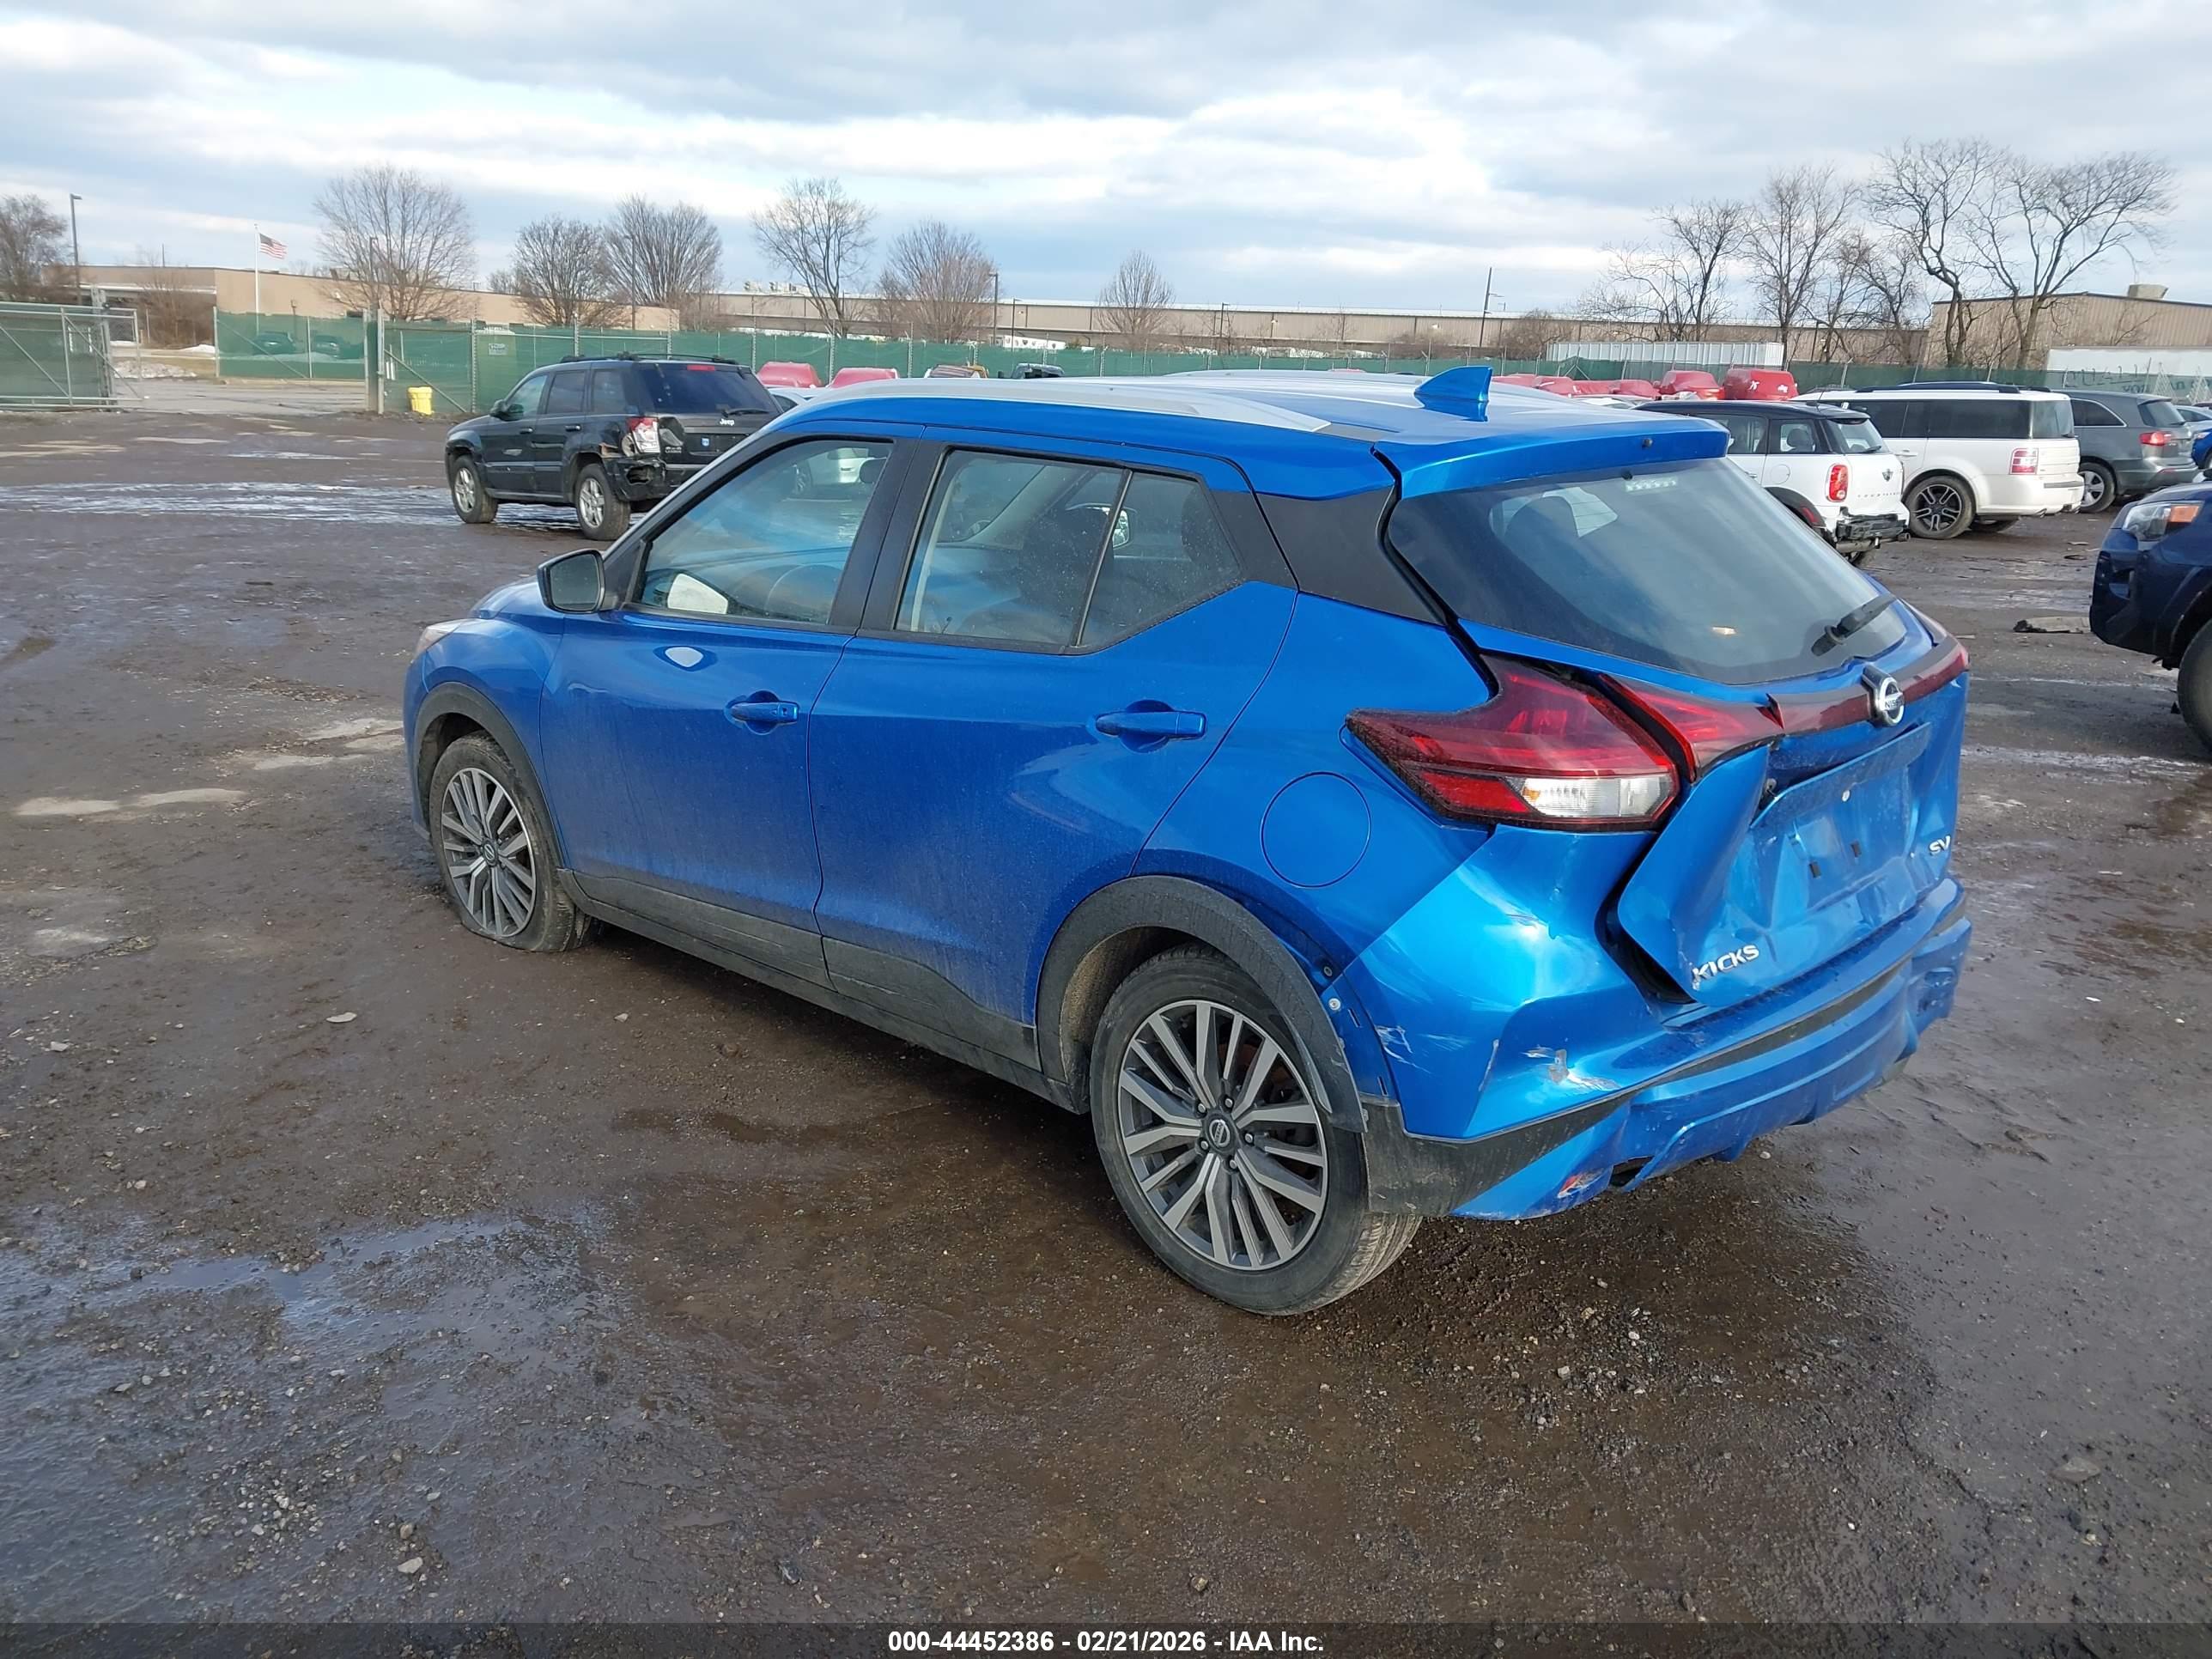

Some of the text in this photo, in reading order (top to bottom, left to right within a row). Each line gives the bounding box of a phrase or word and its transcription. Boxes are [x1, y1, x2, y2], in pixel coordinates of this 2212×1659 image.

[720, 418, 735, 427] Jeep
[1929, 835, 1951, 855] SV
[1692, 944, 1759, 981] KICKS
